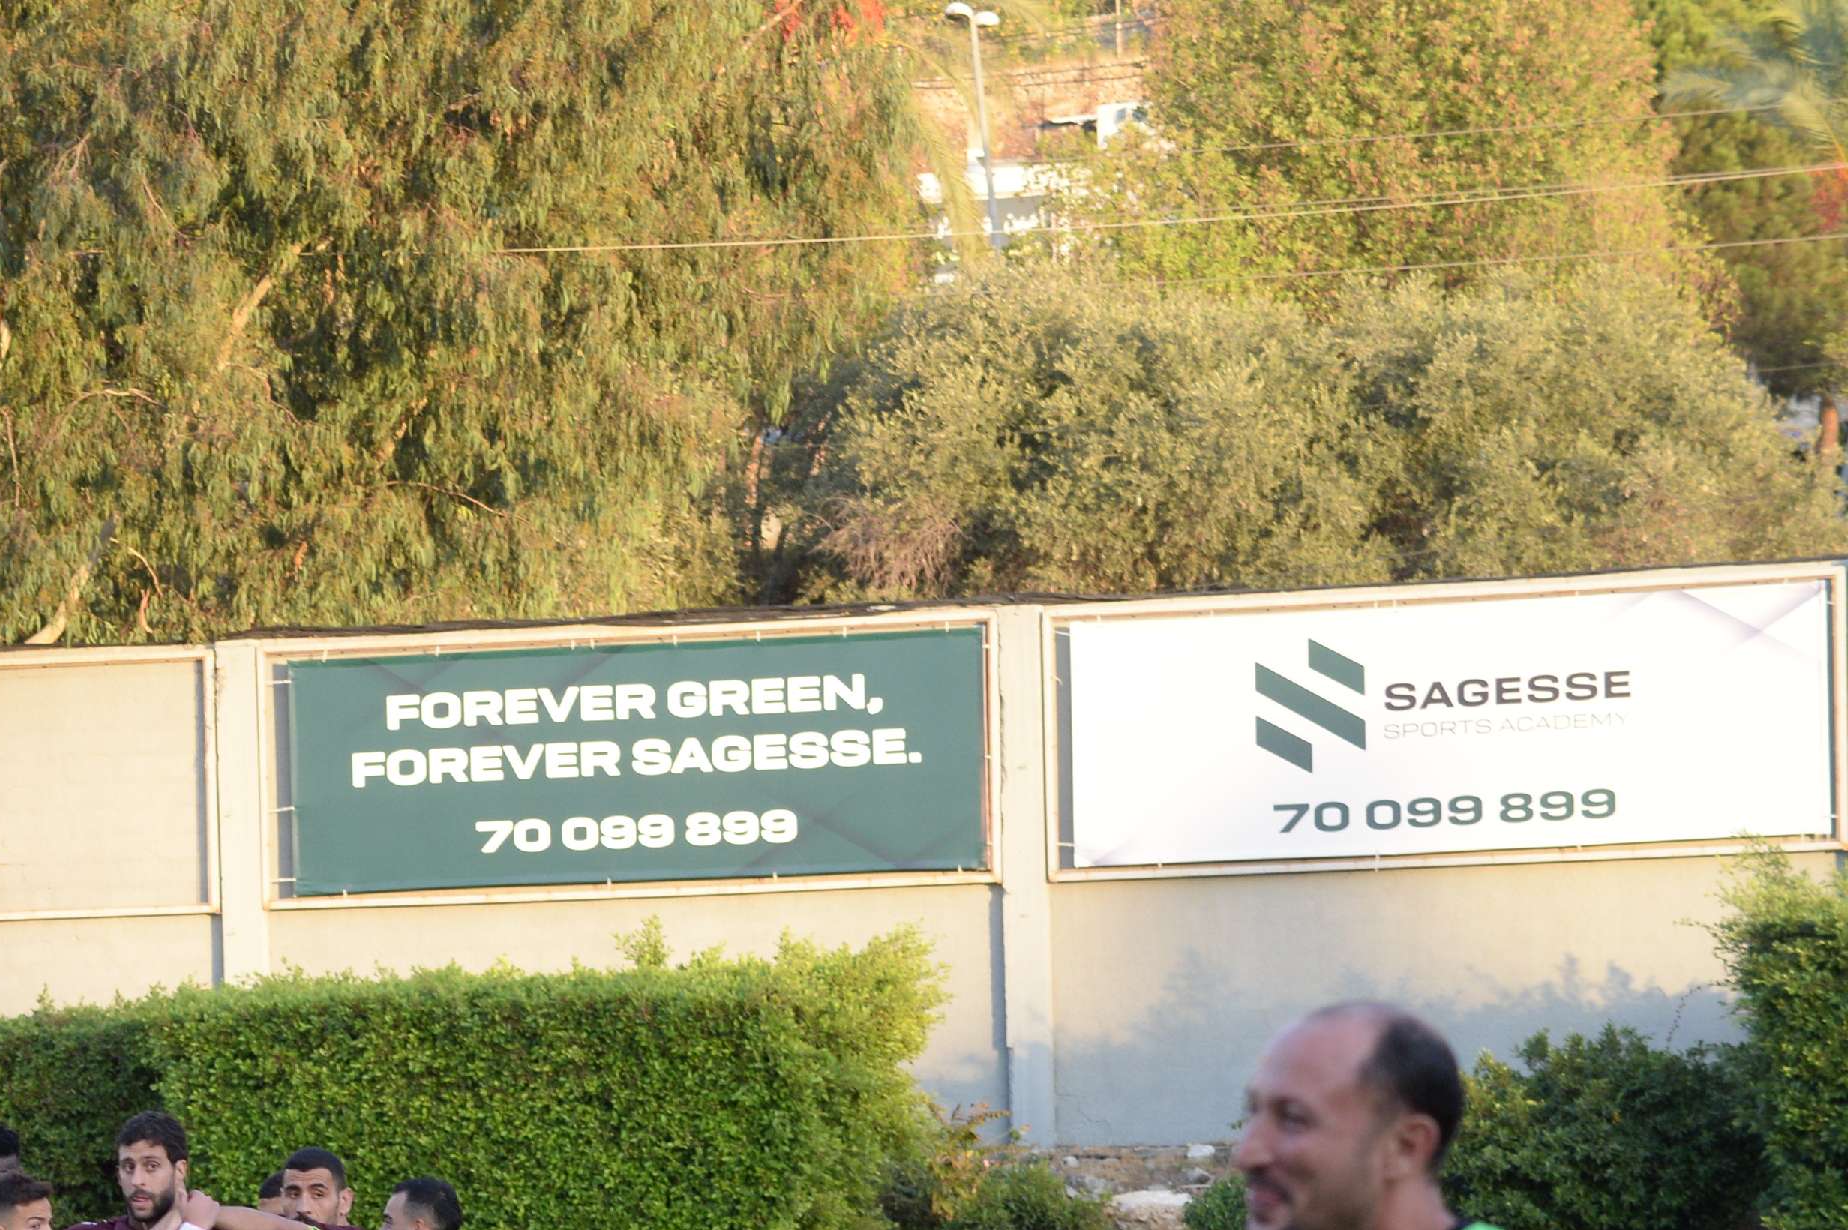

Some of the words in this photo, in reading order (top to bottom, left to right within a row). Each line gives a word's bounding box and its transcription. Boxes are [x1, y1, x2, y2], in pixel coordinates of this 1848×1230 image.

[386, 683, 656, 731] FOREVER
[666, 673, 884, 719] GREEN,
[1384, 670, 1631, 711] SAGESSE
[1383, 718, 1492, 740] SPORTS
[1499, 712, 1630, 732] ACADEMY
[351, 740, 621, 788] FOREVER
[631, 727, 922, 776] SAGESSE.
[475, 818, 551, 854] 70
[561, 814, 675, 851] 099
[685, 808, 798, 846] 899
[1272, 801, 1350, 834] 70
[1365, 795, 1483, 831] 099
[1499, 788, 1616, 824] 899
